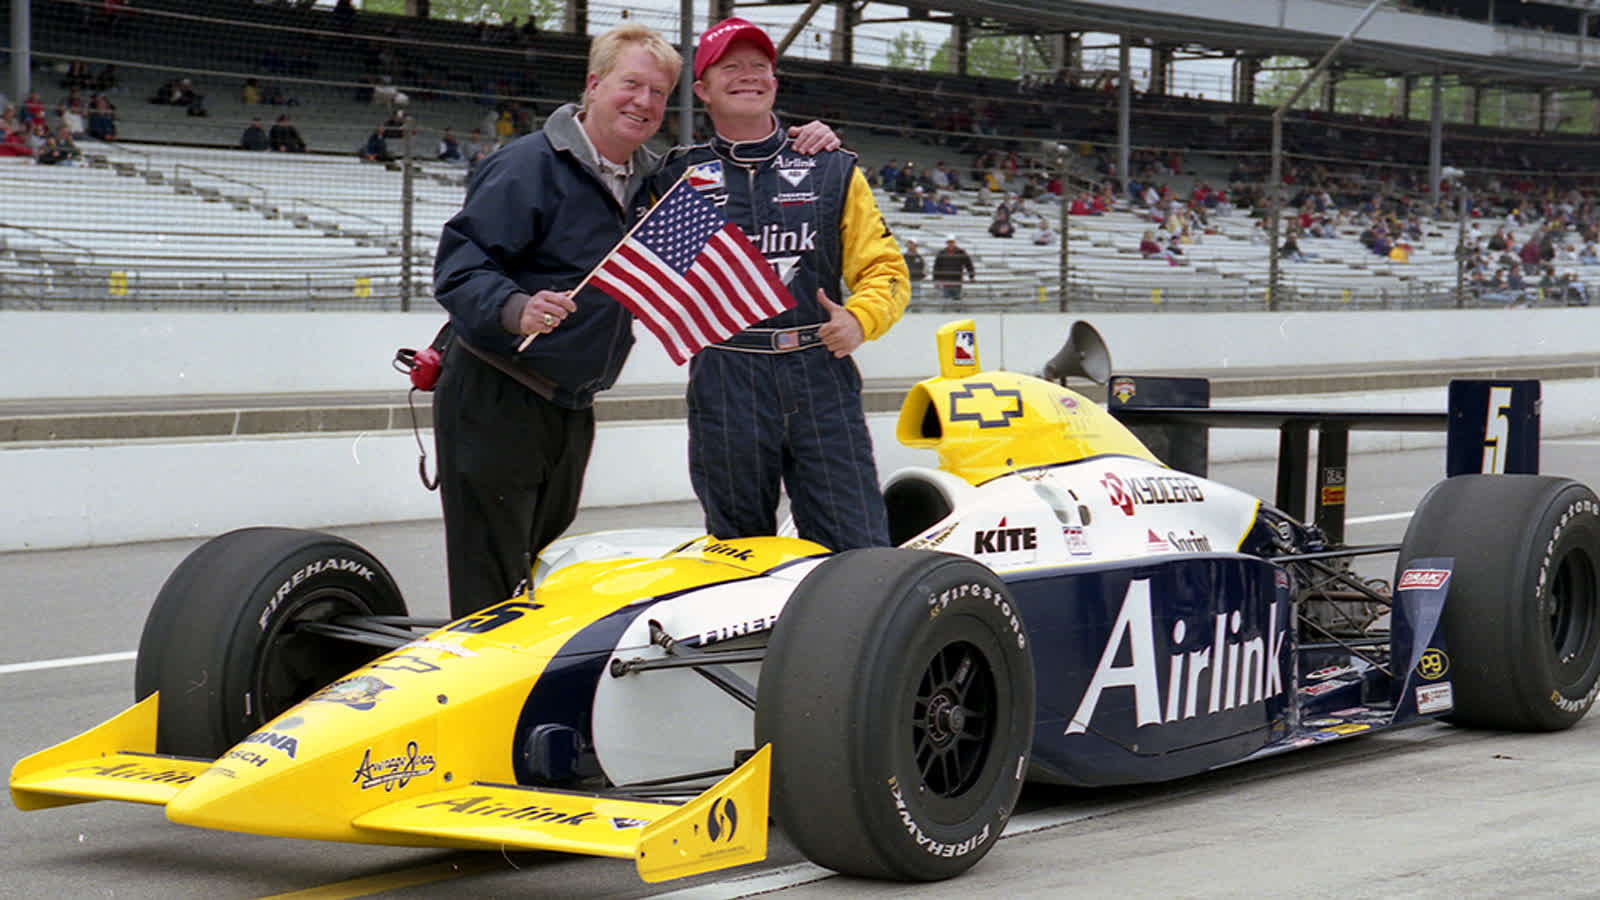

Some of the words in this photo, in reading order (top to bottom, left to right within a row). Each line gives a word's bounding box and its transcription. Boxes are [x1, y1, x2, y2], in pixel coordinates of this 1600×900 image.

[771, 155, 817, 168] Airlink
[1481, 386, 1513, 475] 5
[1124, 477, 1204, 504] KYOCERA
[974, 526, 1037, 554] KITE
[258, 558, 375, 632] FIREHAWK
[446, 602, 545, 634] 5
[928, 583, 1025, 649] Firestone
[1064, 578, 1286, 735] Airlink
[415, 797, 599, 826] Airlink
[892, 786, 990, 858] FIREHAWK
